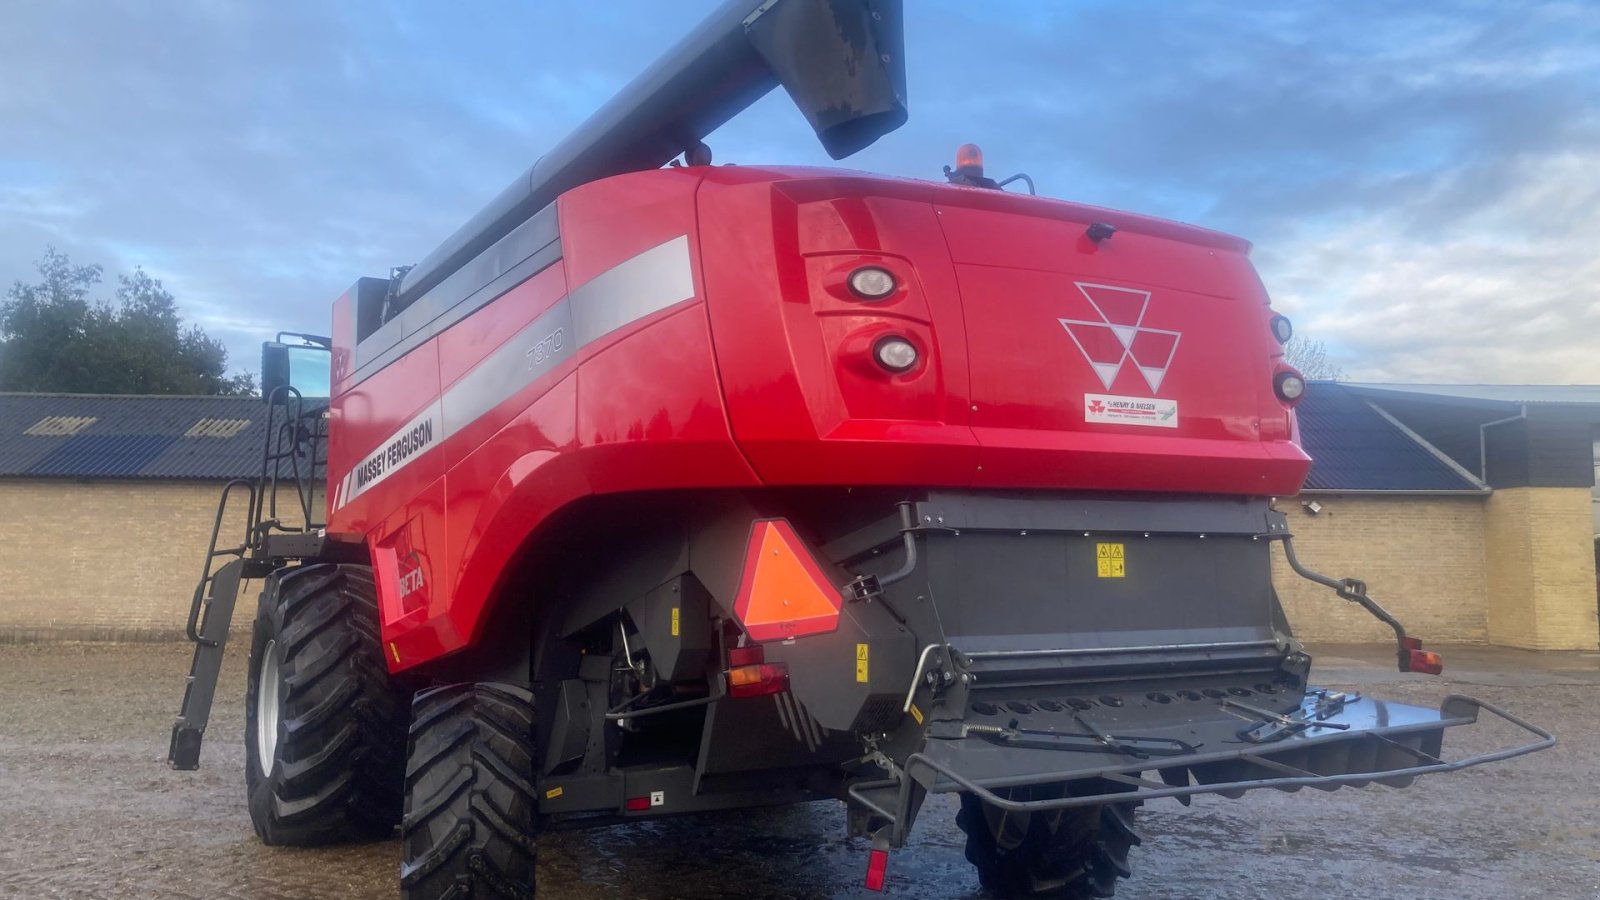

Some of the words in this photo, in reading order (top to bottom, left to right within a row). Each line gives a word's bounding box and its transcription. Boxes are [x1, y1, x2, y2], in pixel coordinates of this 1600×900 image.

[526, 327, 563, 370] 7370
[357, 450, 386, 489] MASSEY
[387, 418, 433, 469] FERGUSON
[400, 566, 424, 598] BETA
